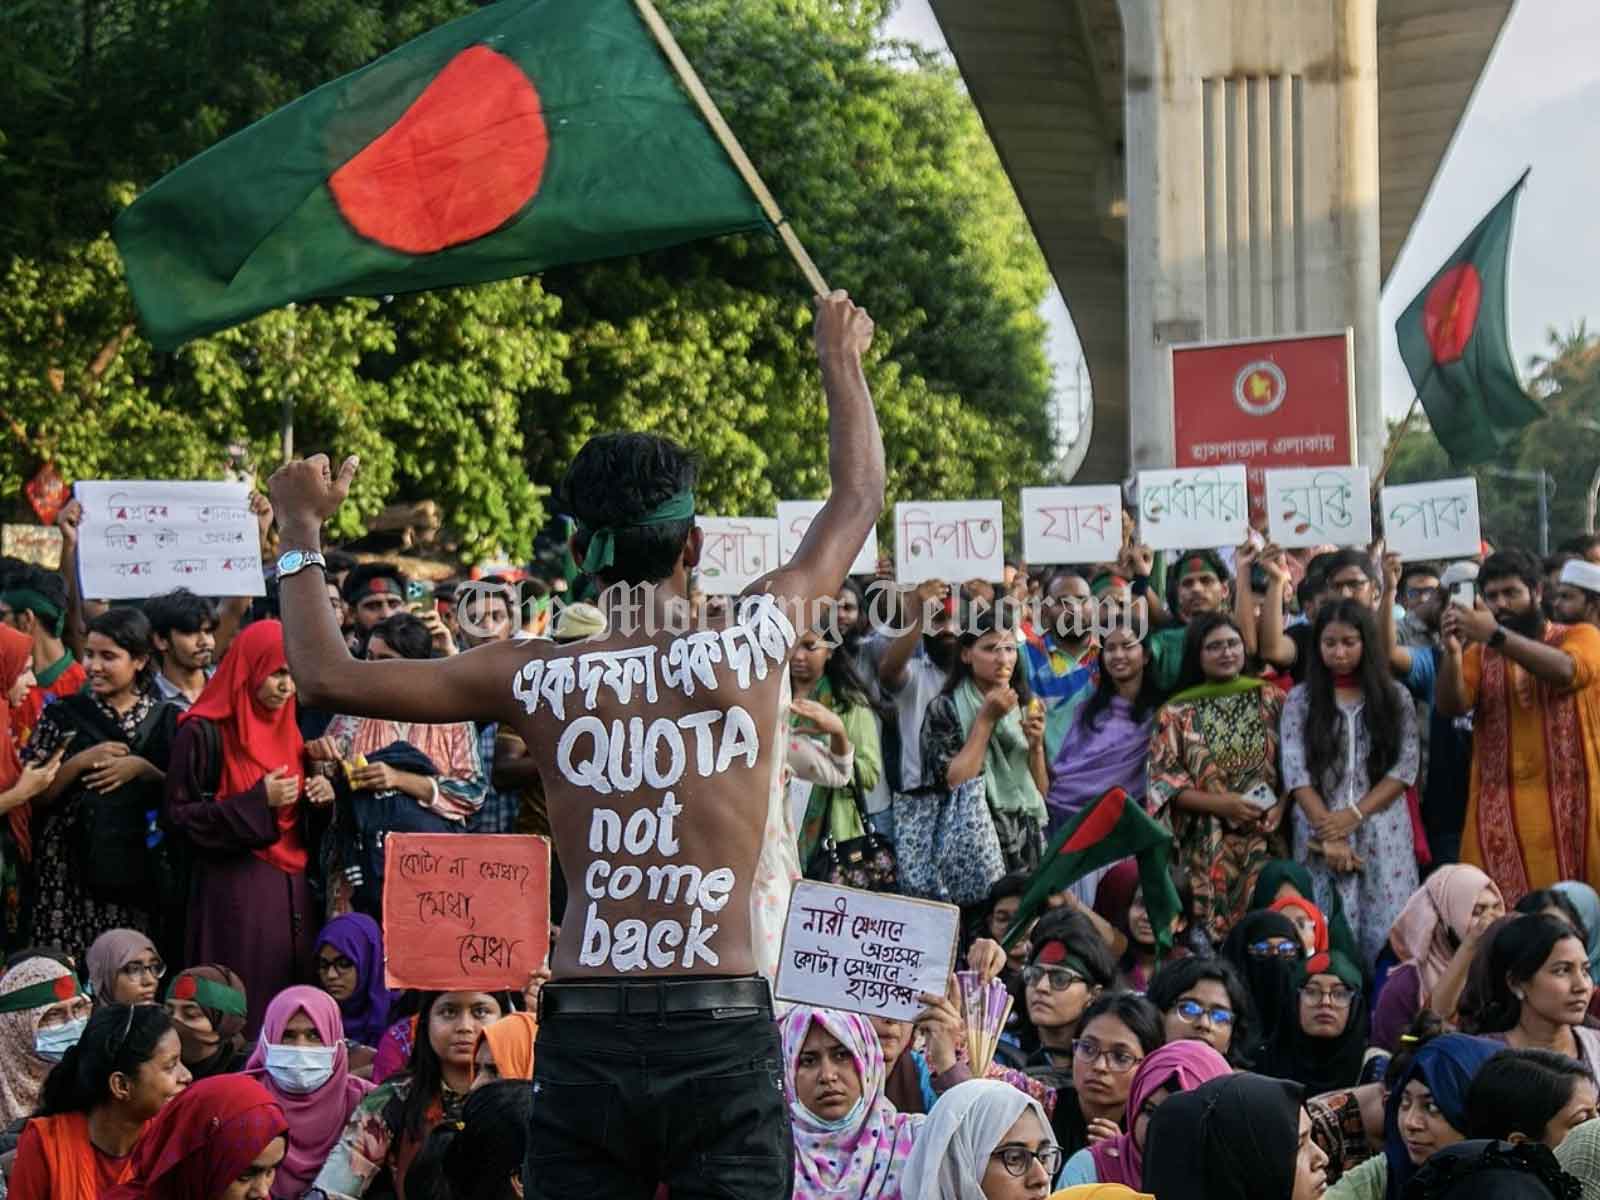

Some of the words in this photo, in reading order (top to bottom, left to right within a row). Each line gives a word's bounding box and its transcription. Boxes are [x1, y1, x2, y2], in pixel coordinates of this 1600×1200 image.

[1190, 438, 1267, 463] হাসপাতাল
[1272, 432, 1336, 456] এলাকায়
[1036, 504, 1113, 543] যাক
[1278, 471, 1353, 536] মুক্তি
[1389, 494, 1470, 540] পাক
[903, 508, 998, 563] নিপাত
[556, 705, 759, 794] QUOTA
[588, 790, 683, 857] not
[400, 849, 443, 880] কোটা
[449, 857, 469, 878] না
[585, 859, 735, 912] come
[578, 901, 719, 972] back
[800, 897, 848, 937] নারী
[851, 915, 907, 942] যেখানে
[457, 934, 525, 976] মেধা
[794, 946, 840, 977] কোটা
[844, 957, 904, 984] সেখানে
